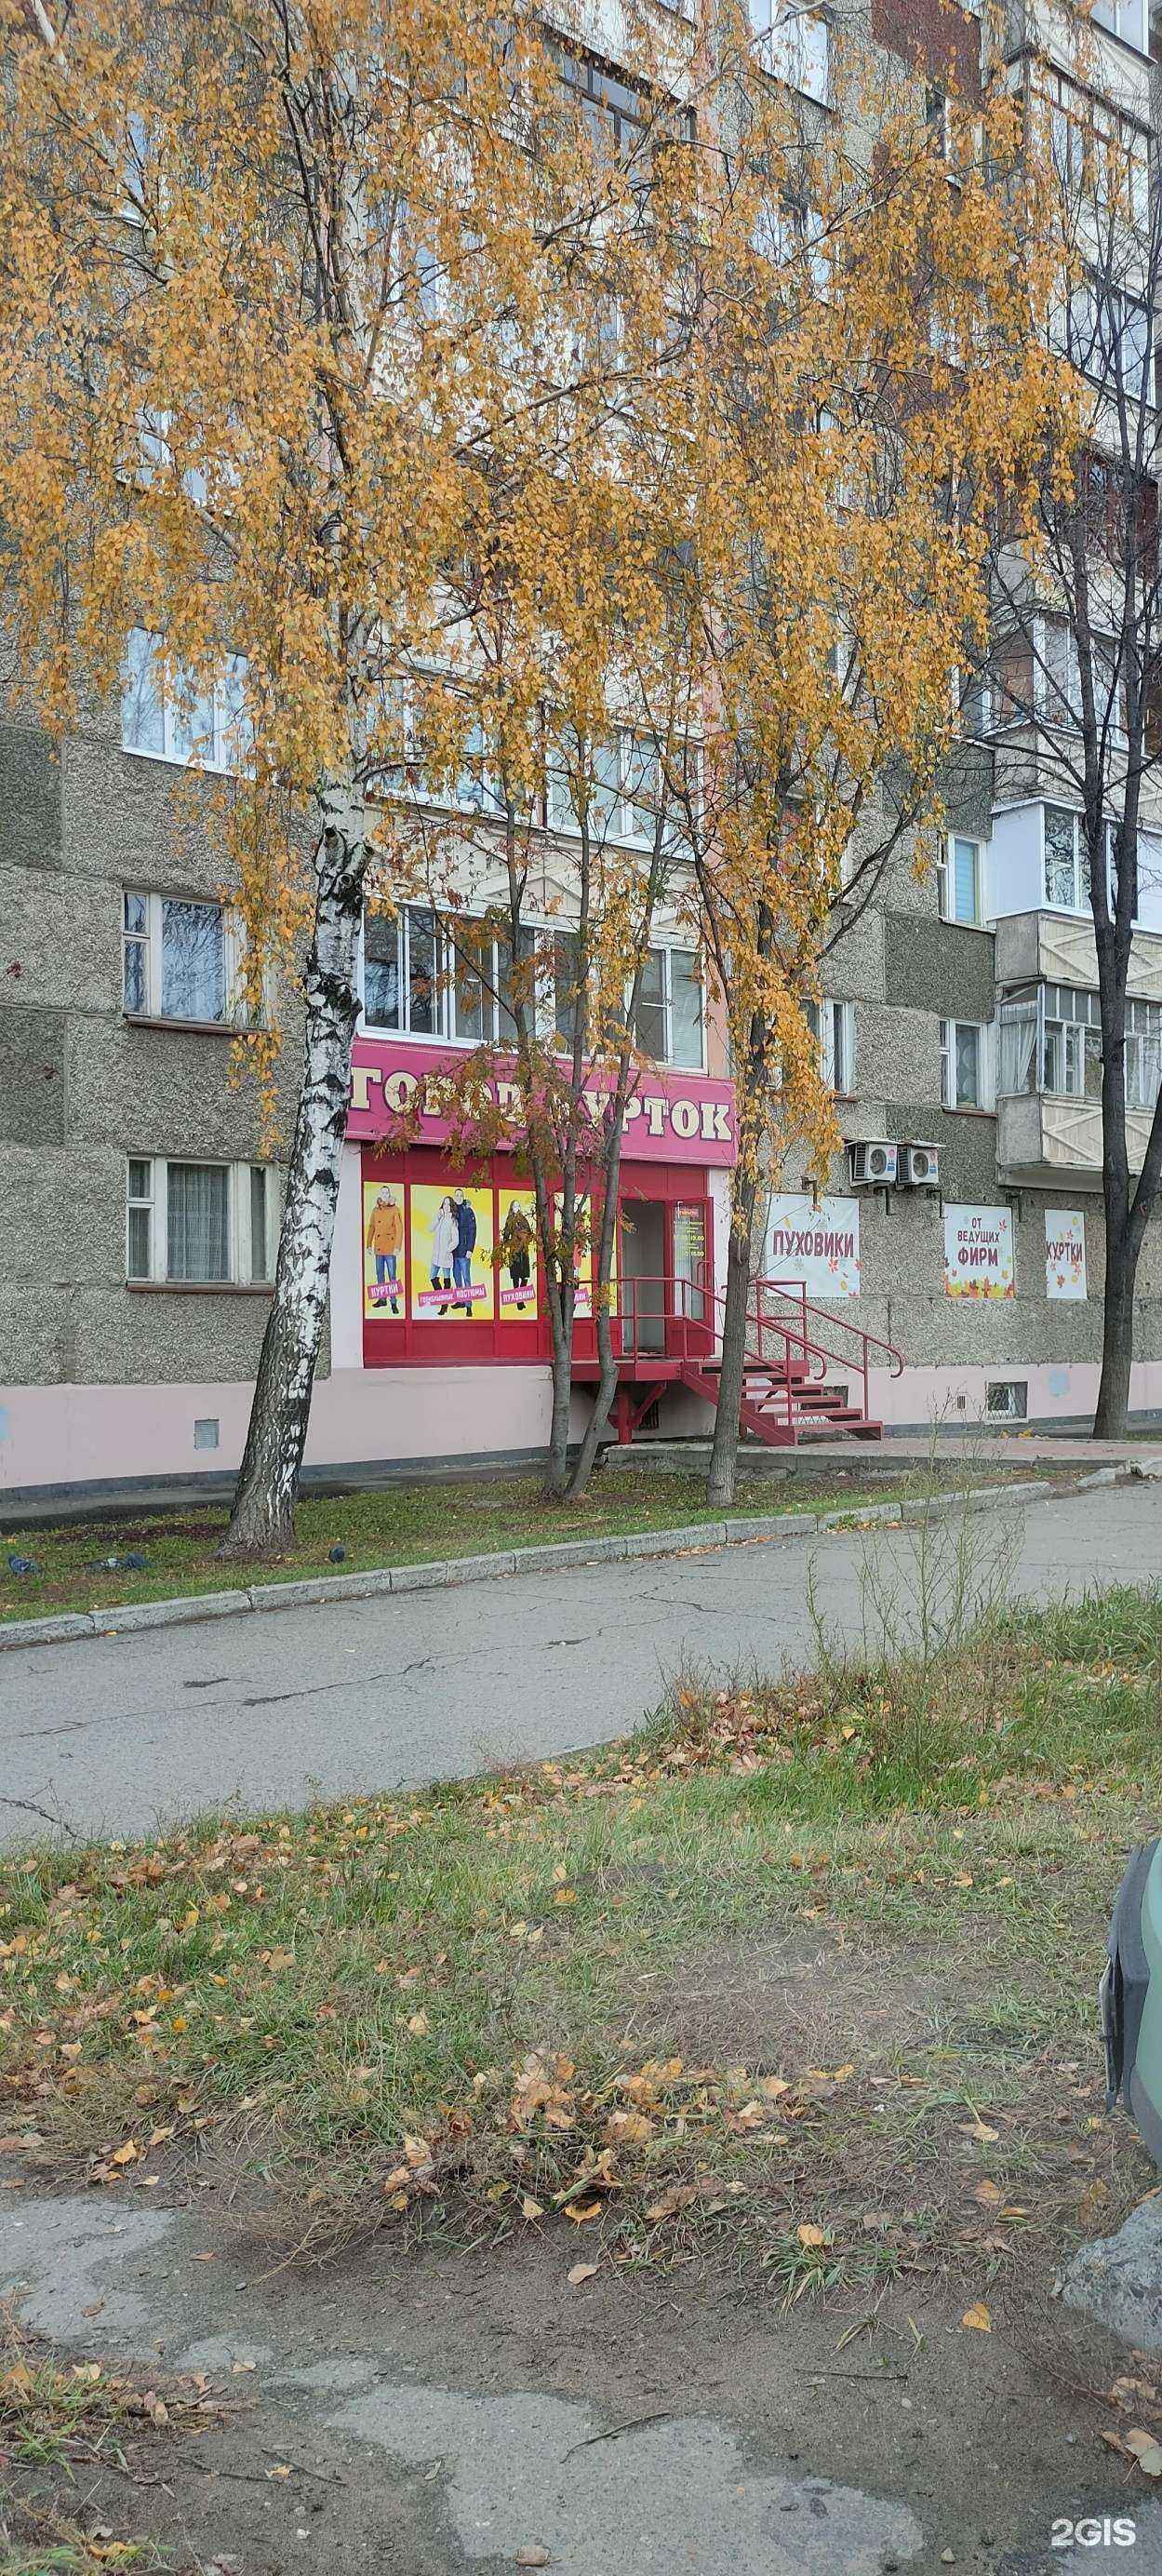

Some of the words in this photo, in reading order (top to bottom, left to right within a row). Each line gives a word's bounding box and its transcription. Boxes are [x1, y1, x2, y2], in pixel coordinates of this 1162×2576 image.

[971, 1217, 982, 1228] ОТ
[773, 1230, 854, 1257] ПУХОВИКИ
[957, 1230, 1000, 1244] ВЕДУЩИХ
[957, 1247, 998, 1267] ФИРМ
[370, 1283, 399, 1297] КУРТКИ
[502, 1289, 535, 1303] ПУХОВИКИ
